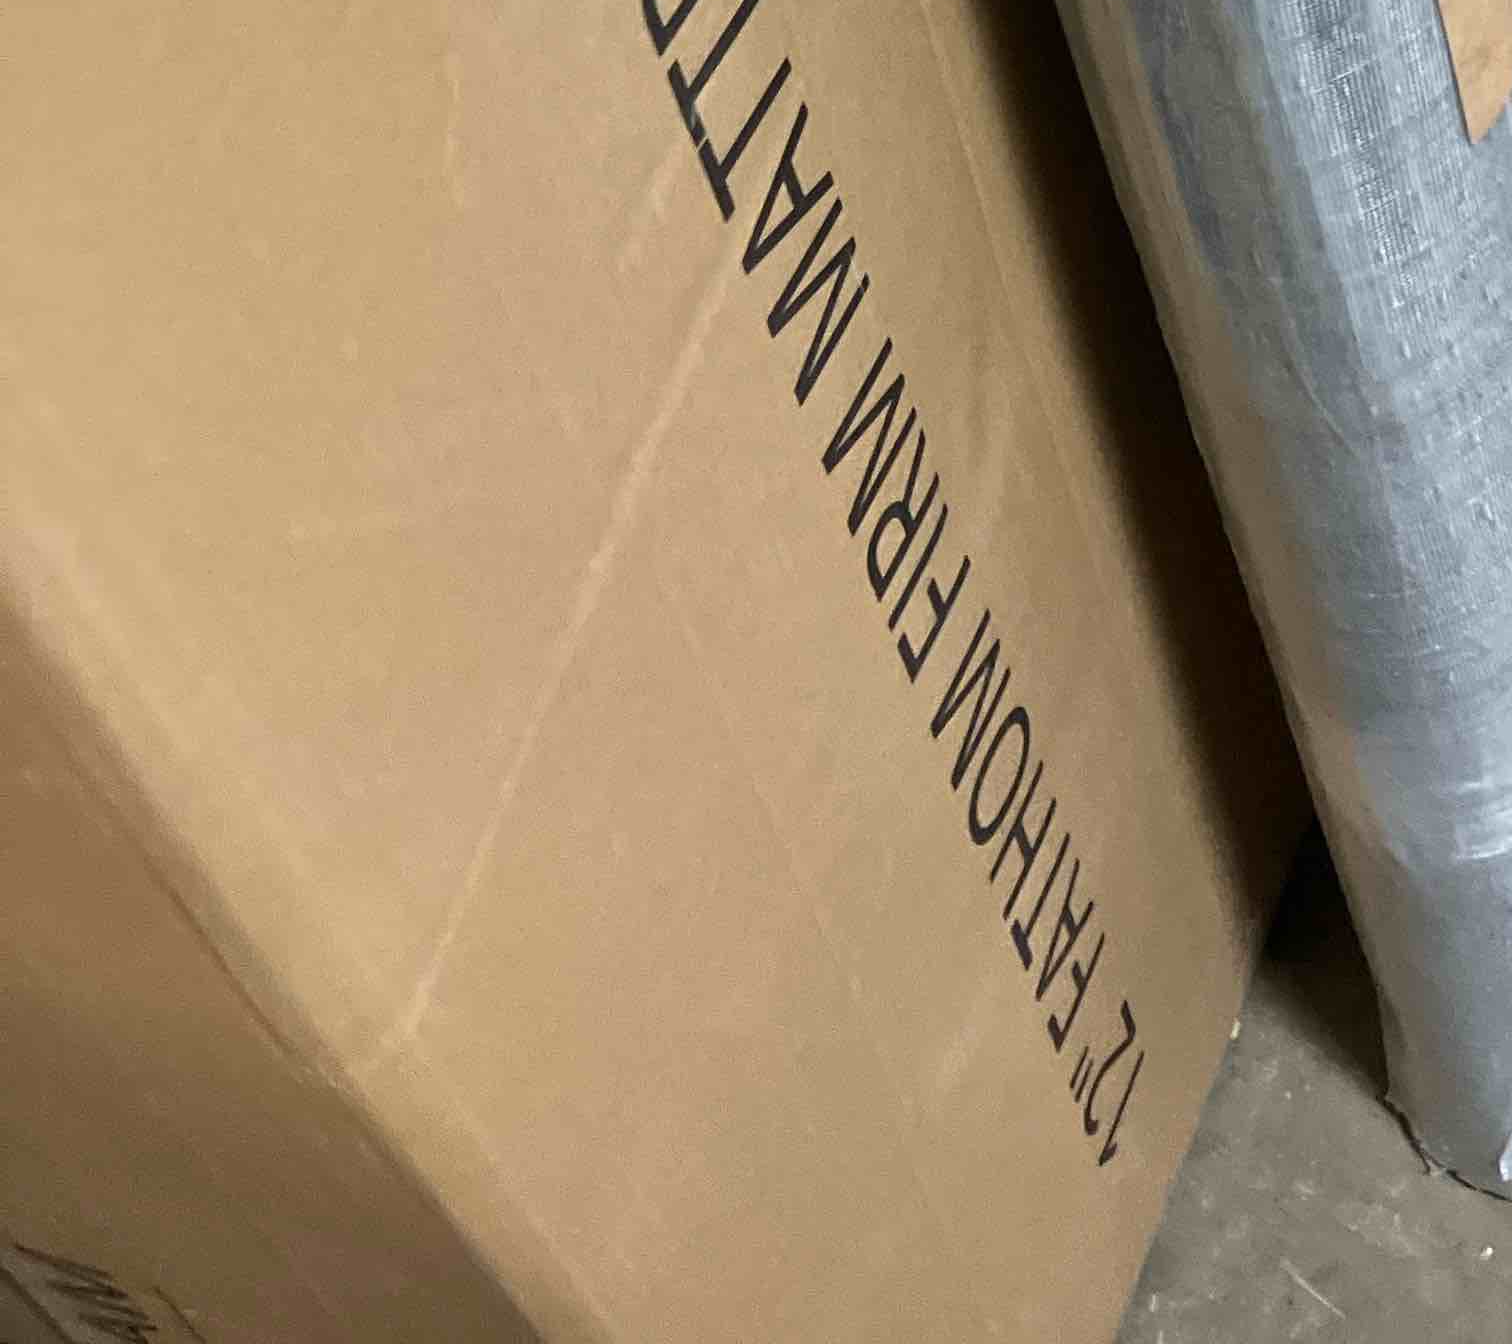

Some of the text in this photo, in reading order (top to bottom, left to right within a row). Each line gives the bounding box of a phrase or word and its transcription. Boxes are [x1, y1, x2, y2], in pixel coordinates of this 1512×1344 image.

[821, 336, 972, 684] FIRM
[929, 607, 1105, 1053] FATHOM
[1070, 997, 1144, 1168] 12"
